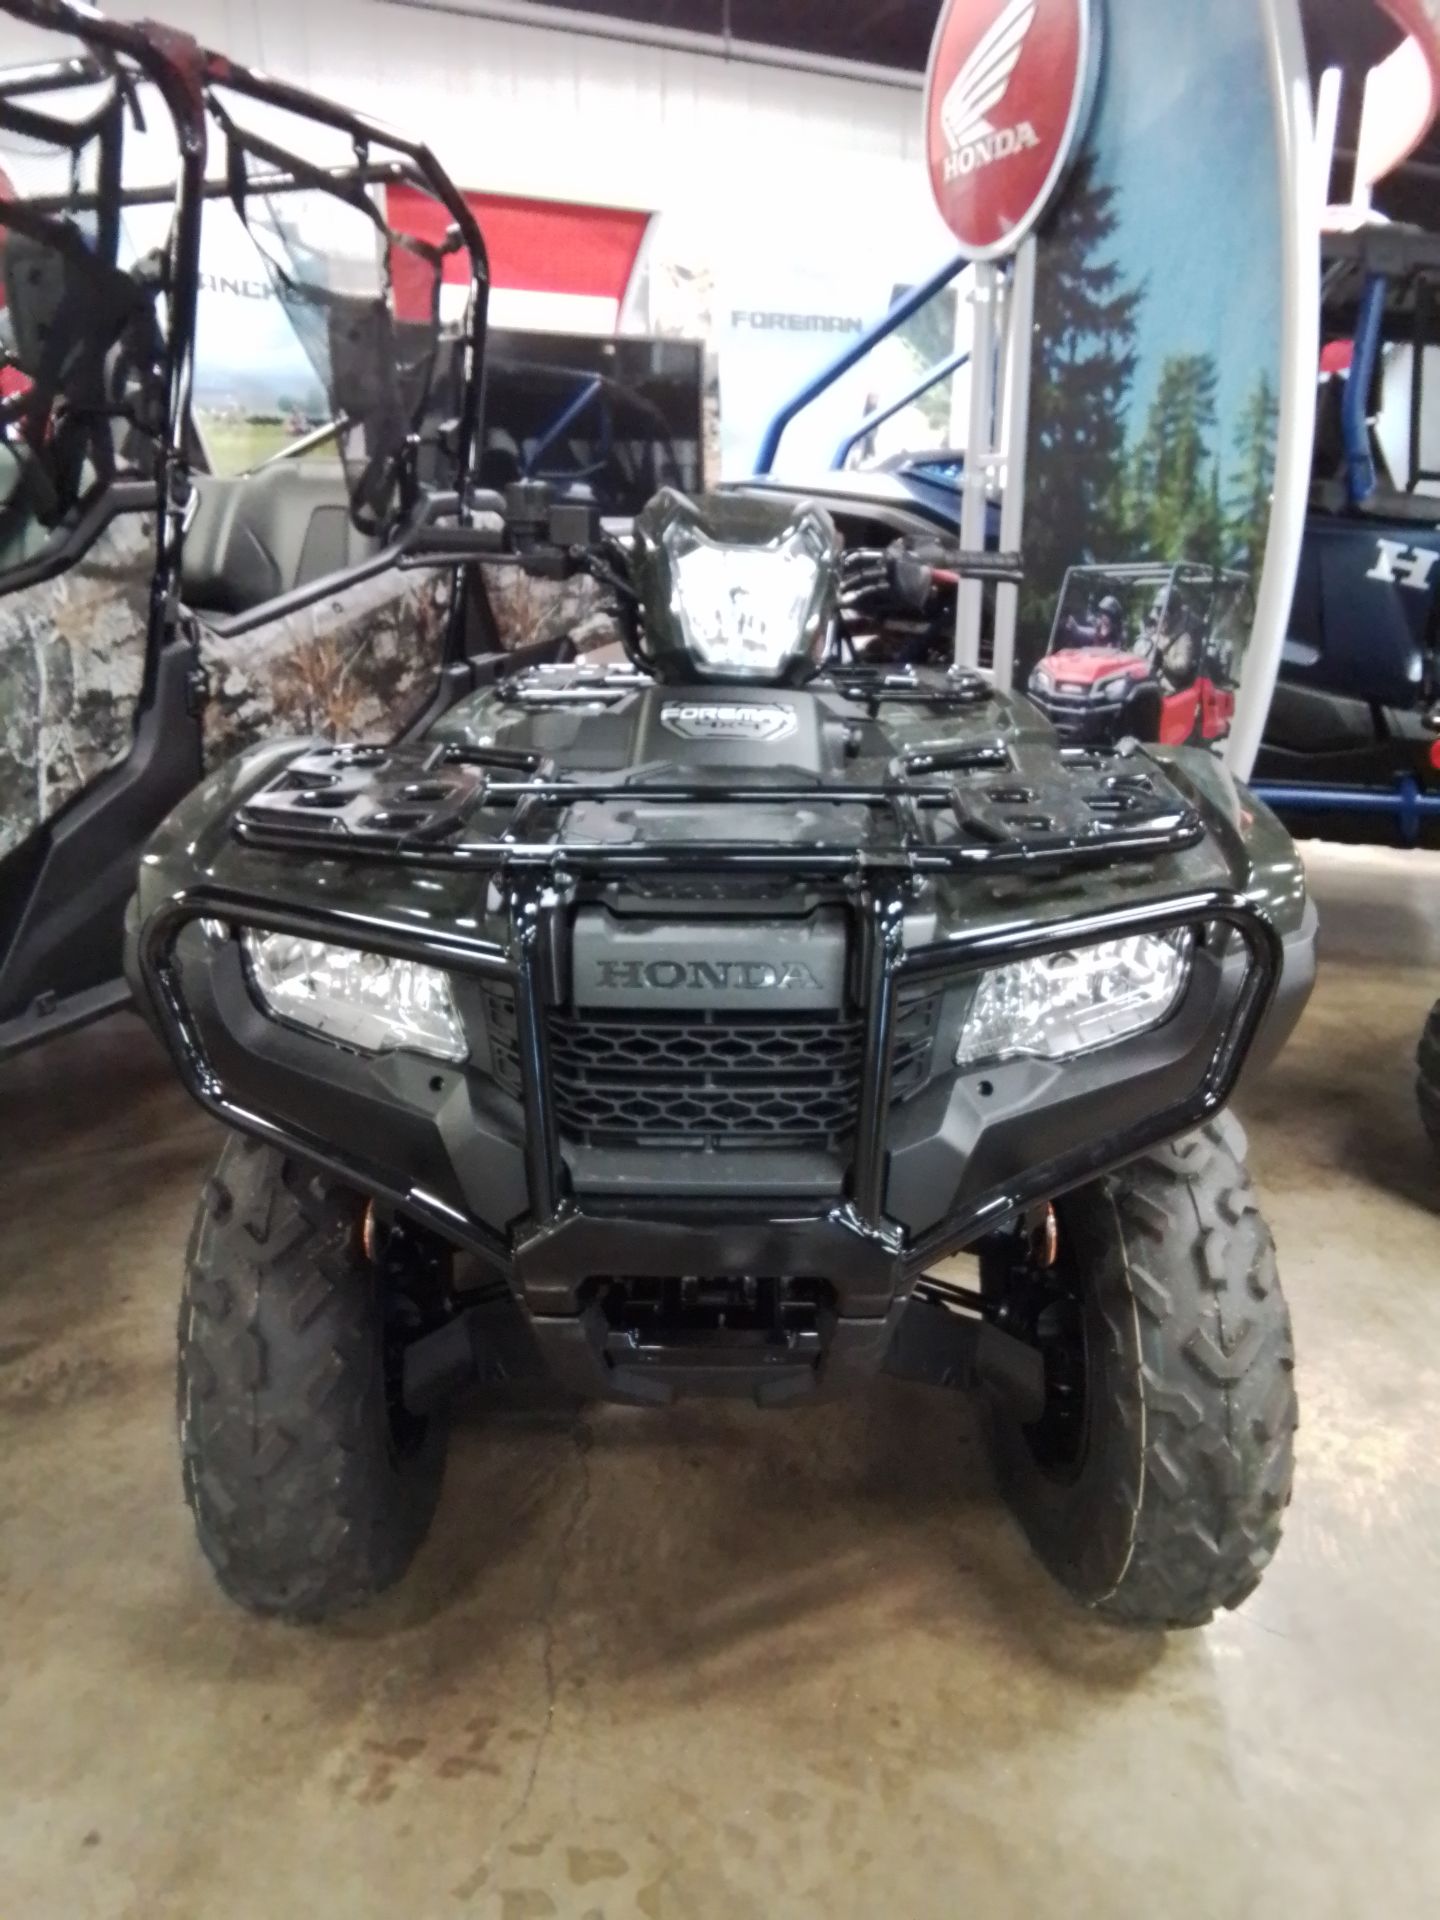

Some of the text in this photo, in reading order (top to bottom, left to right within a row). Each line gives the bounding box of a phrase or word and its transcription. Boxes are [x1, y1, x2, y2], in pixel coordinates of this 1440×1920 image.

[943, 121, 1040, 182] HONDA
[731, 309, 862, 333] FOREMAN
[595, 959, 823, 990] HONDA
